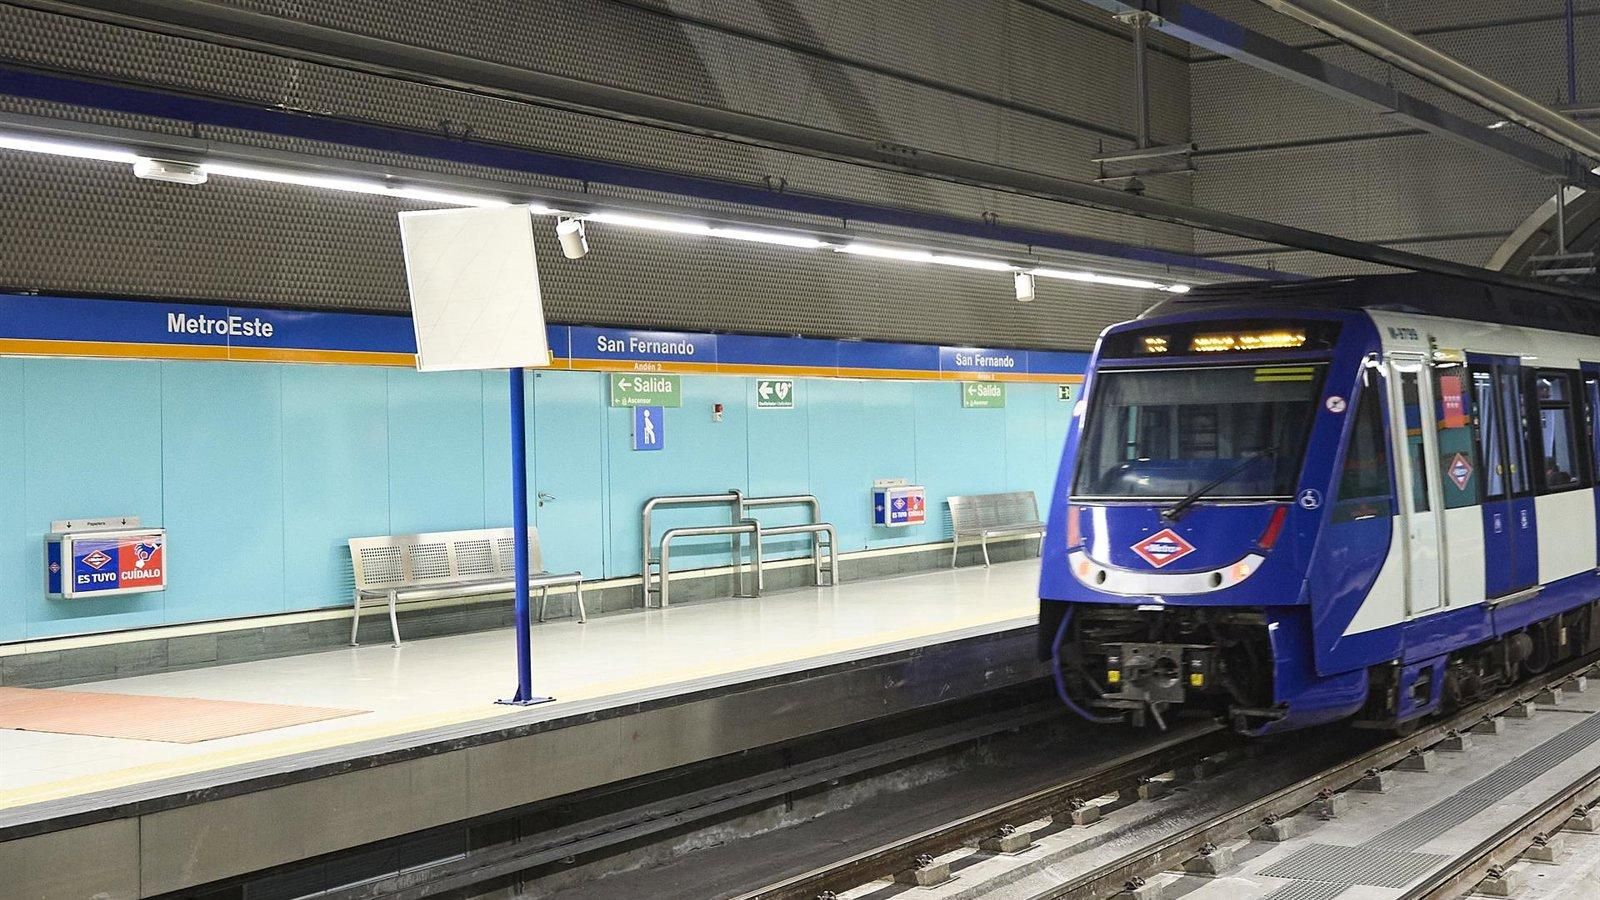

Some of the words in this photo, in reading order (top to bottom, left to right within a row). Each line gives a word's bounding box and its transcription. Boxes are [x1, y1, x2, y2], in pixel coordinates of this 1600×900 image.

[167, 312, 274, 338] MetroEste
[597, 335, 625, 353] San
[630, 337, 695, 355] Fernando
[634, 362, 656, 371] Andén
[956, 353, 973, 366] San
[975, 354, 1015, 368] Fernando
[634, 377, 673, 393] Salida
[977, 384, 1001, 397] Salida
[77, 575, 90, 584] ES
[92, 572, 117, 583] TUYO
[121, 568, 161, 580] CUÍDALO
